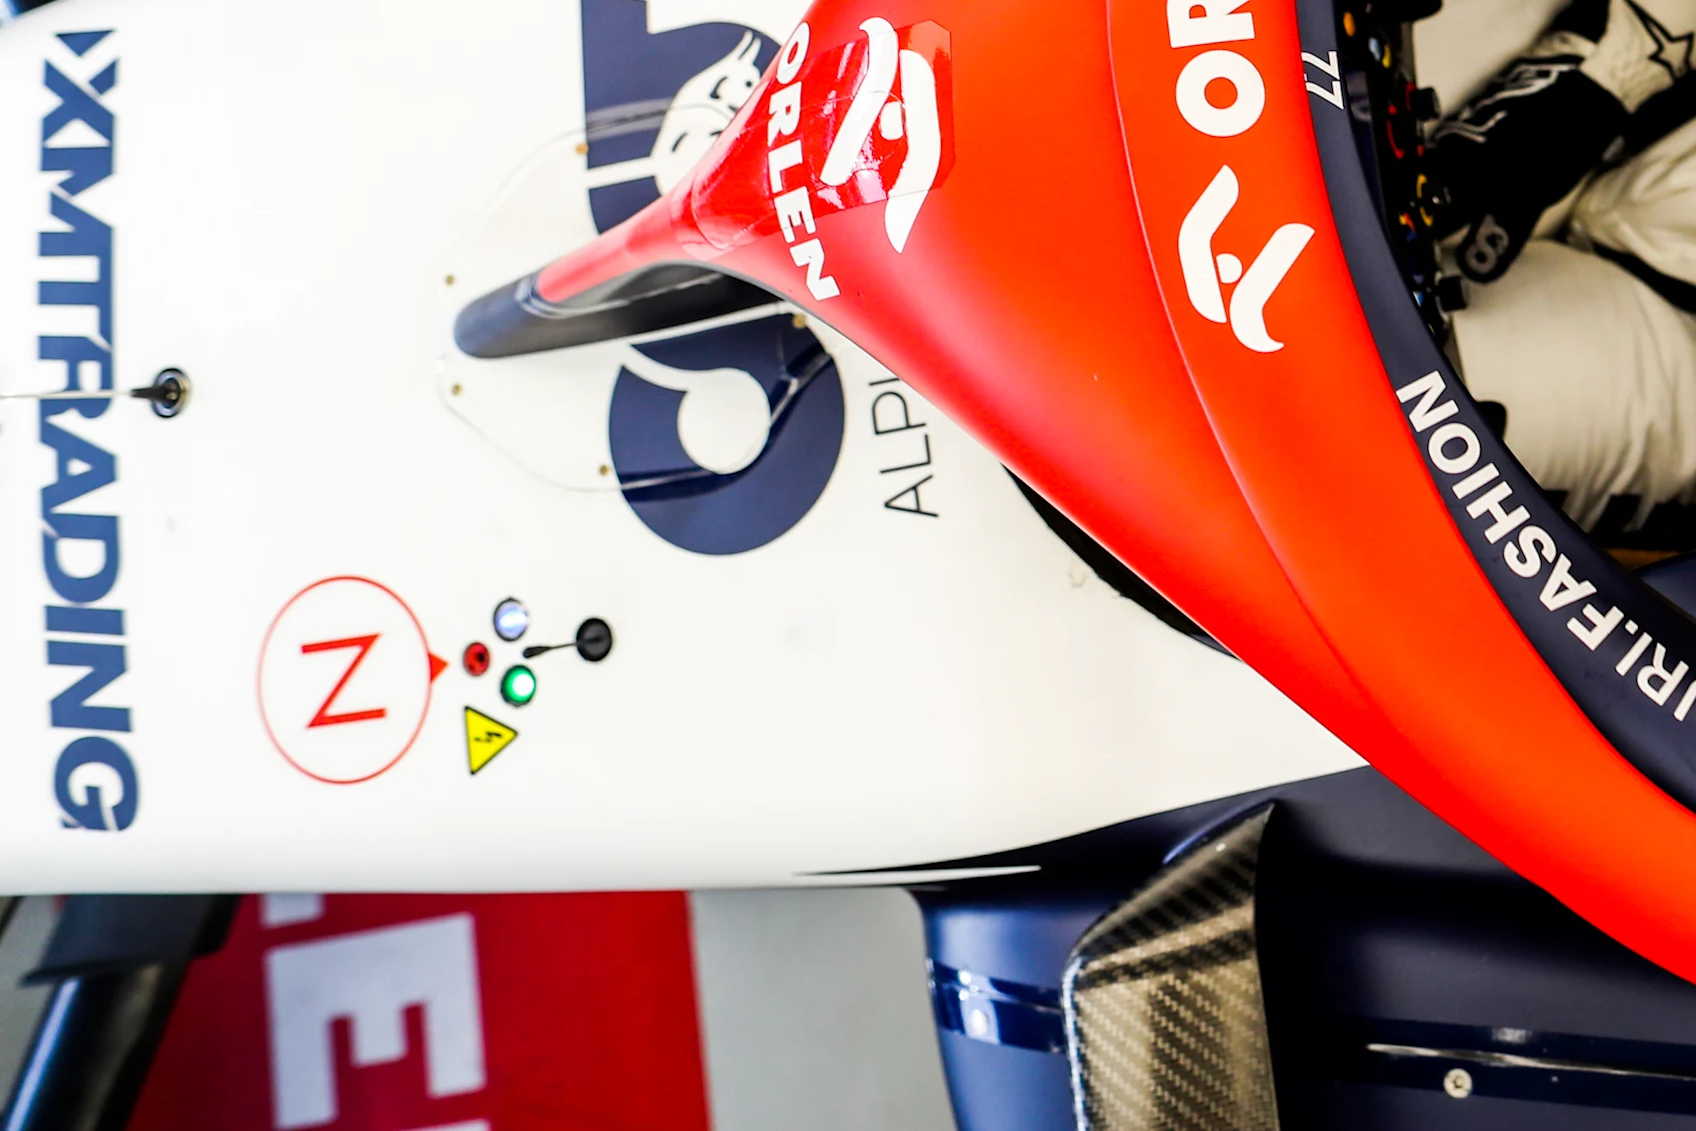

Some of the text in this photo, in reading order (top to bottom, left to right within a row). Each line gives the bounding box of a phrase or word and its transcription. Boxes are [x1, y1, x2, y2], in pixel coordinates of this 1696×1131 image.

[767, 22, 841, 302] ORLEN
[38, 29, 140, 832] XMTRADING
[869, 378, 940, 518] ALP
